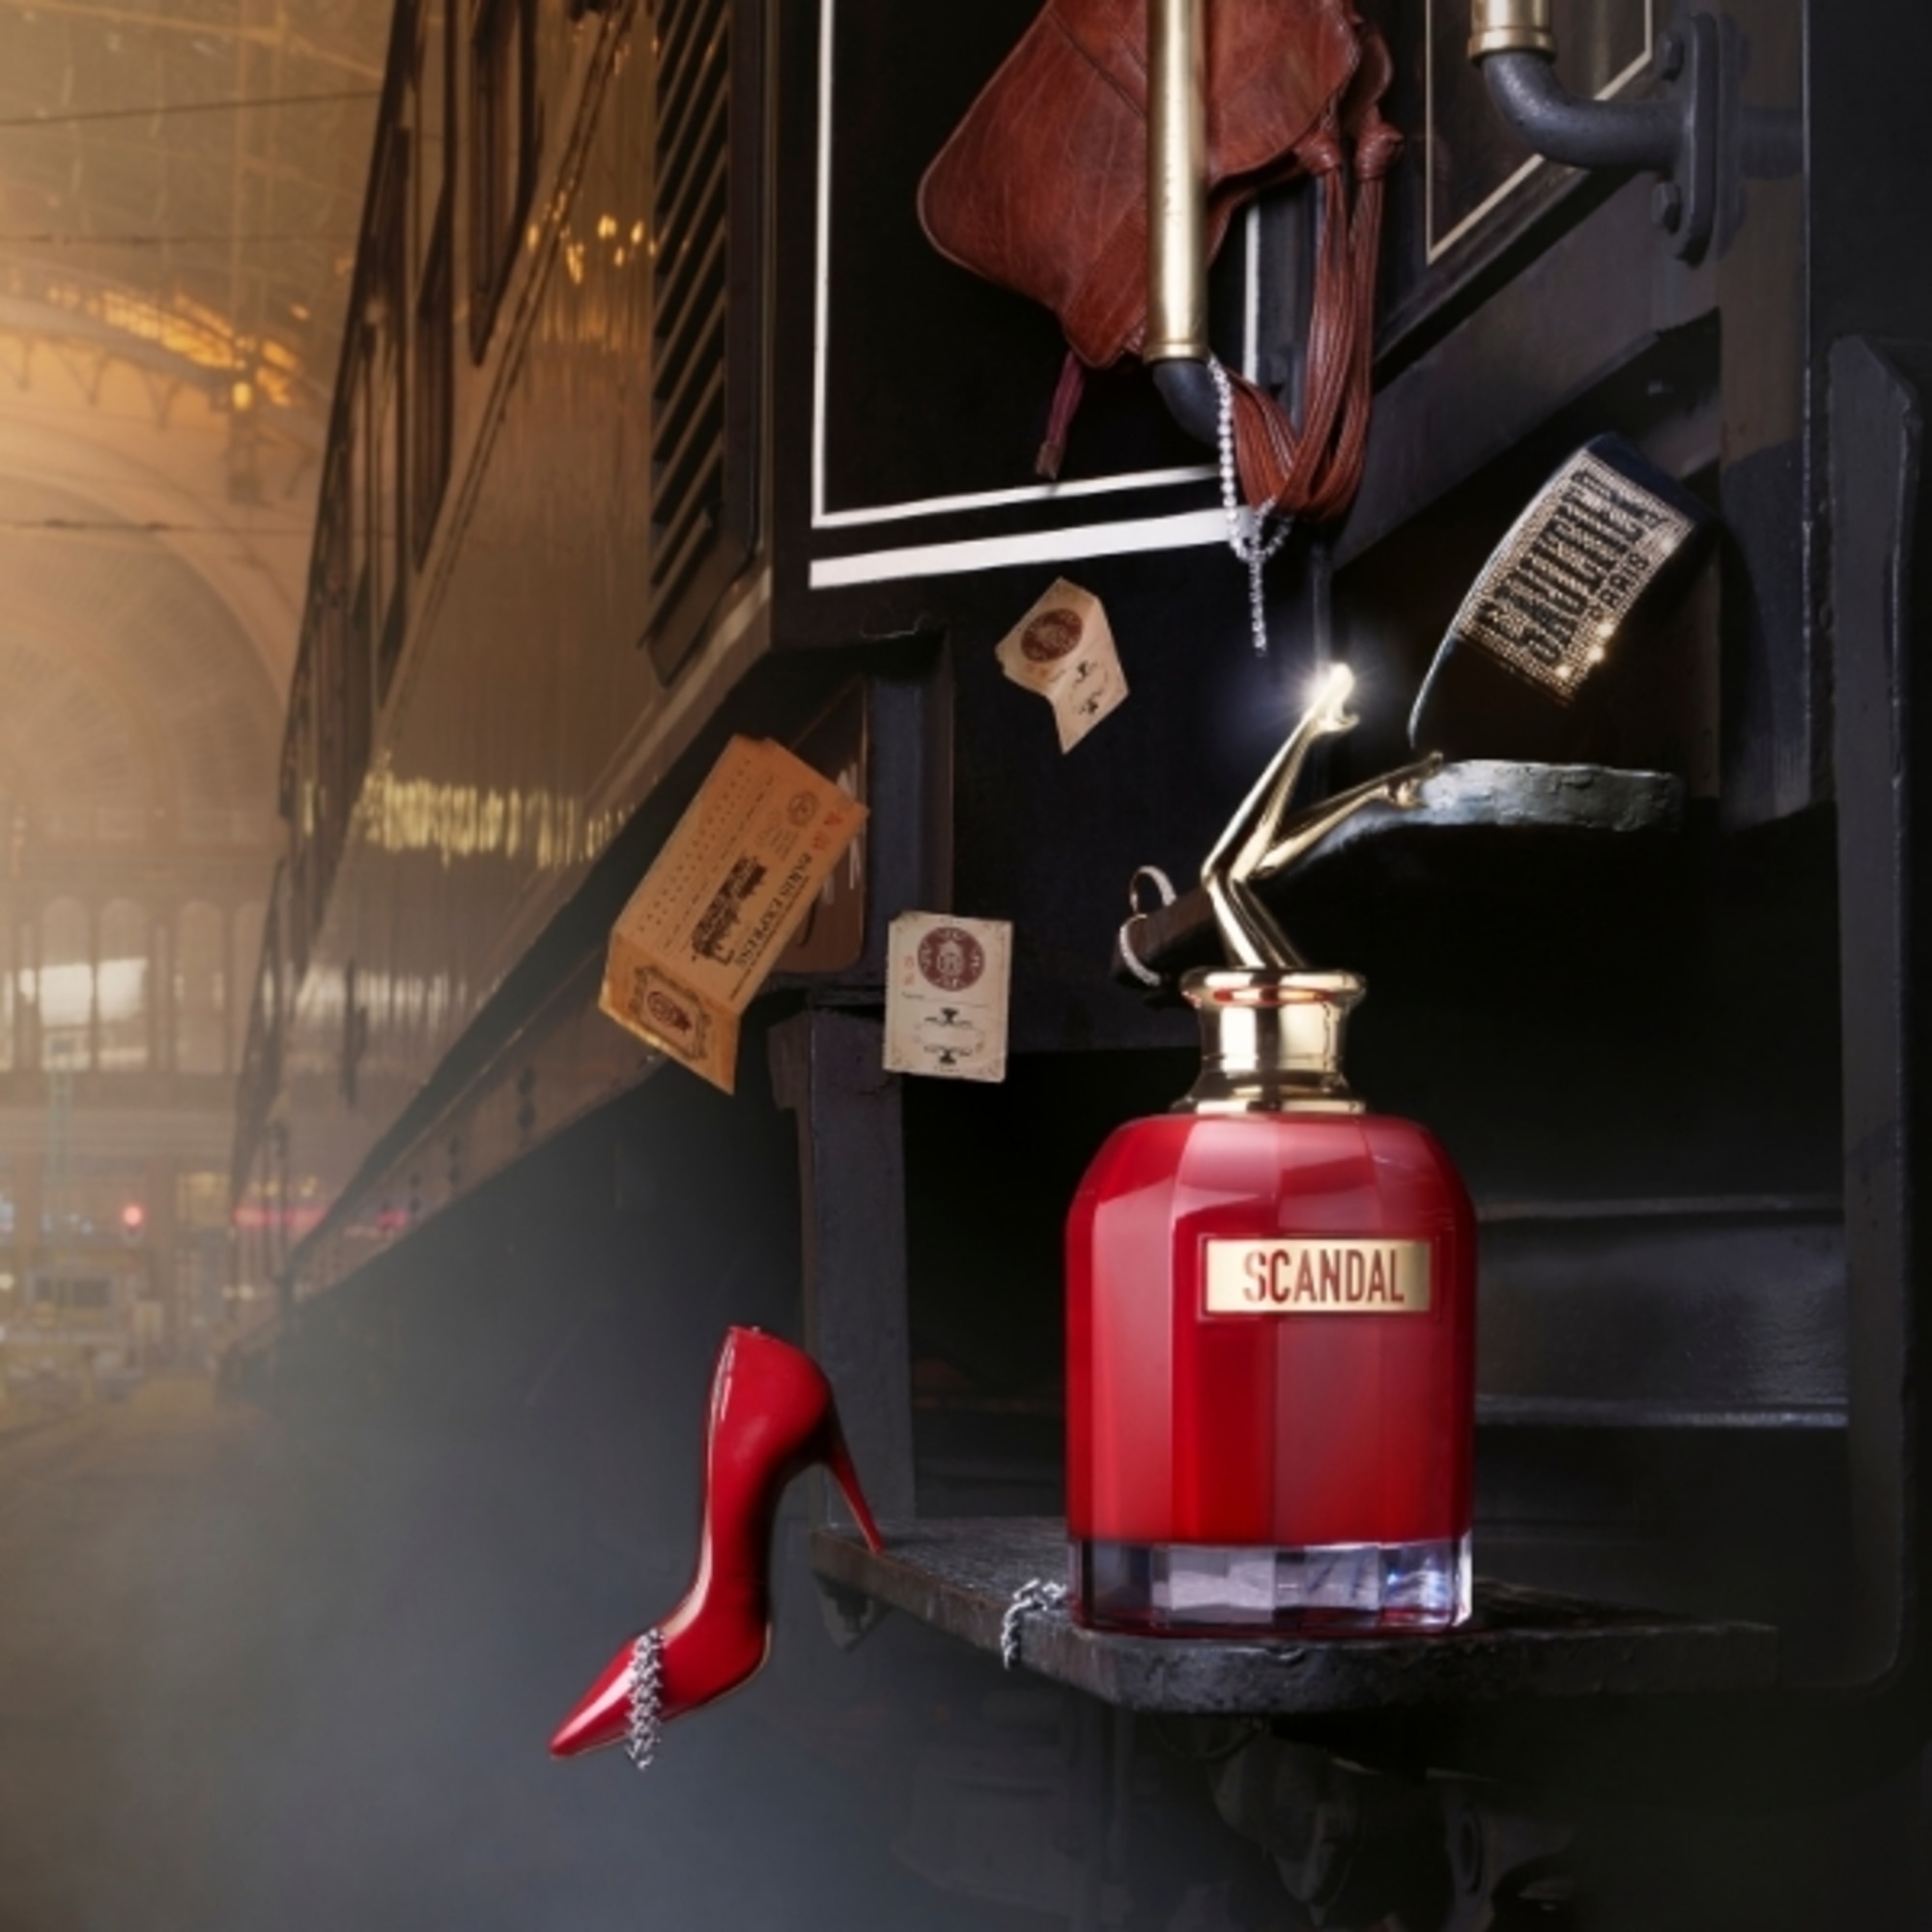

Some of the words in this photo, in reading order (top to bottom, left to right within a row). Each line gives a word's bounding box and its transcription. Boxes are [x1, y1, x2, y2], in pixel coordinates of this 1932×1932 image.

[1474, 469, 1669, 665] GAULTIER
[779, 852, 812, 897] PARIS
[1242, 1249, 1405, 1303] SCANDAL
